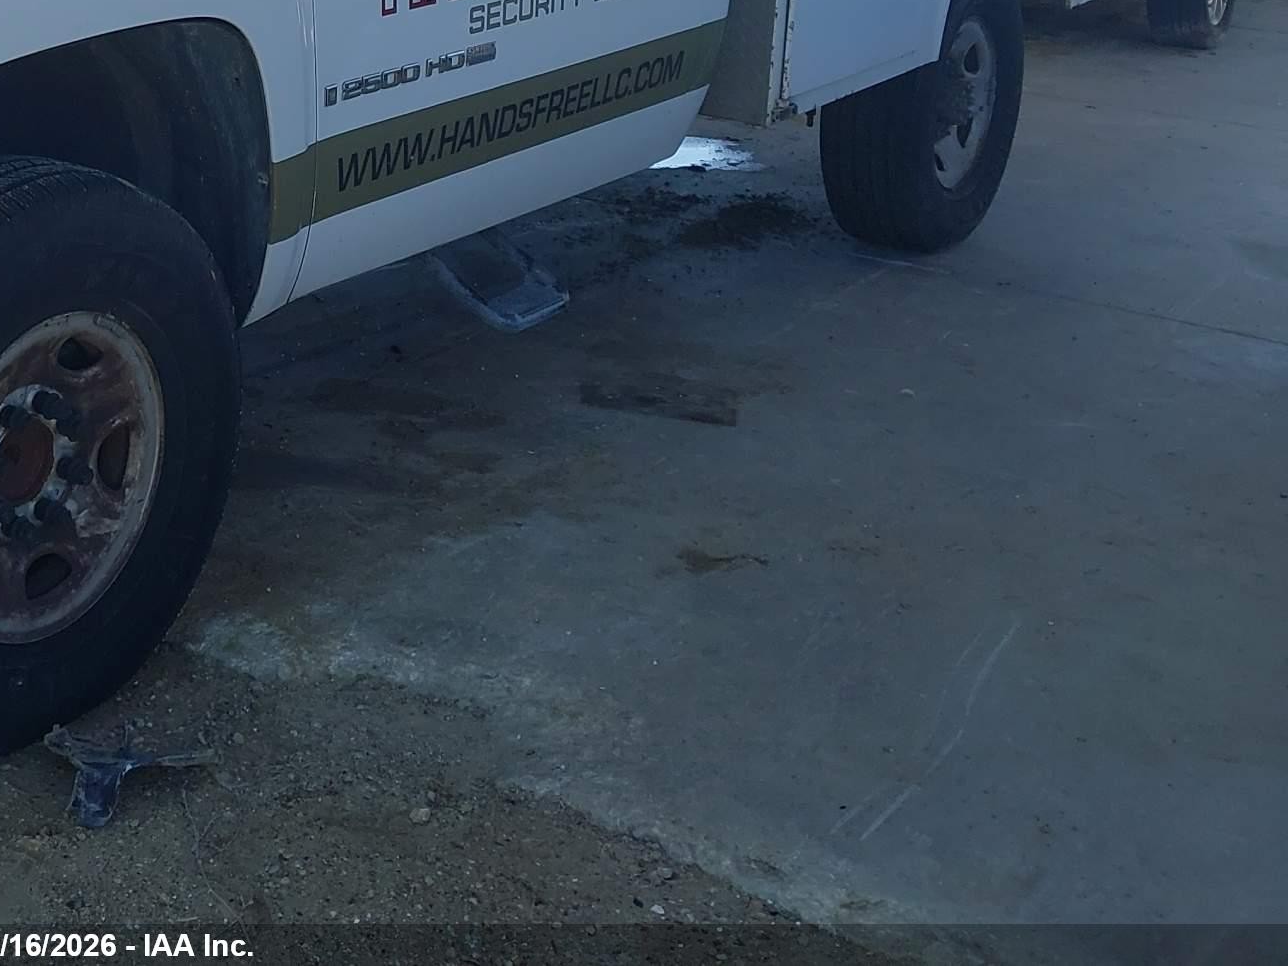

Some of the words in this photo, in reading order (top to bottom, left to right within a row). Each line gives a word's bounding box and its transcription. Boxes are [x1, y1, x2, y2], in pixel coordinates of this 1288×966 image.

[337, 49, 686, 192] WWW.HANDSFREELLC.COM
[341, 62, 421, 101] 2500
[425, 49, 465, 78] HD
